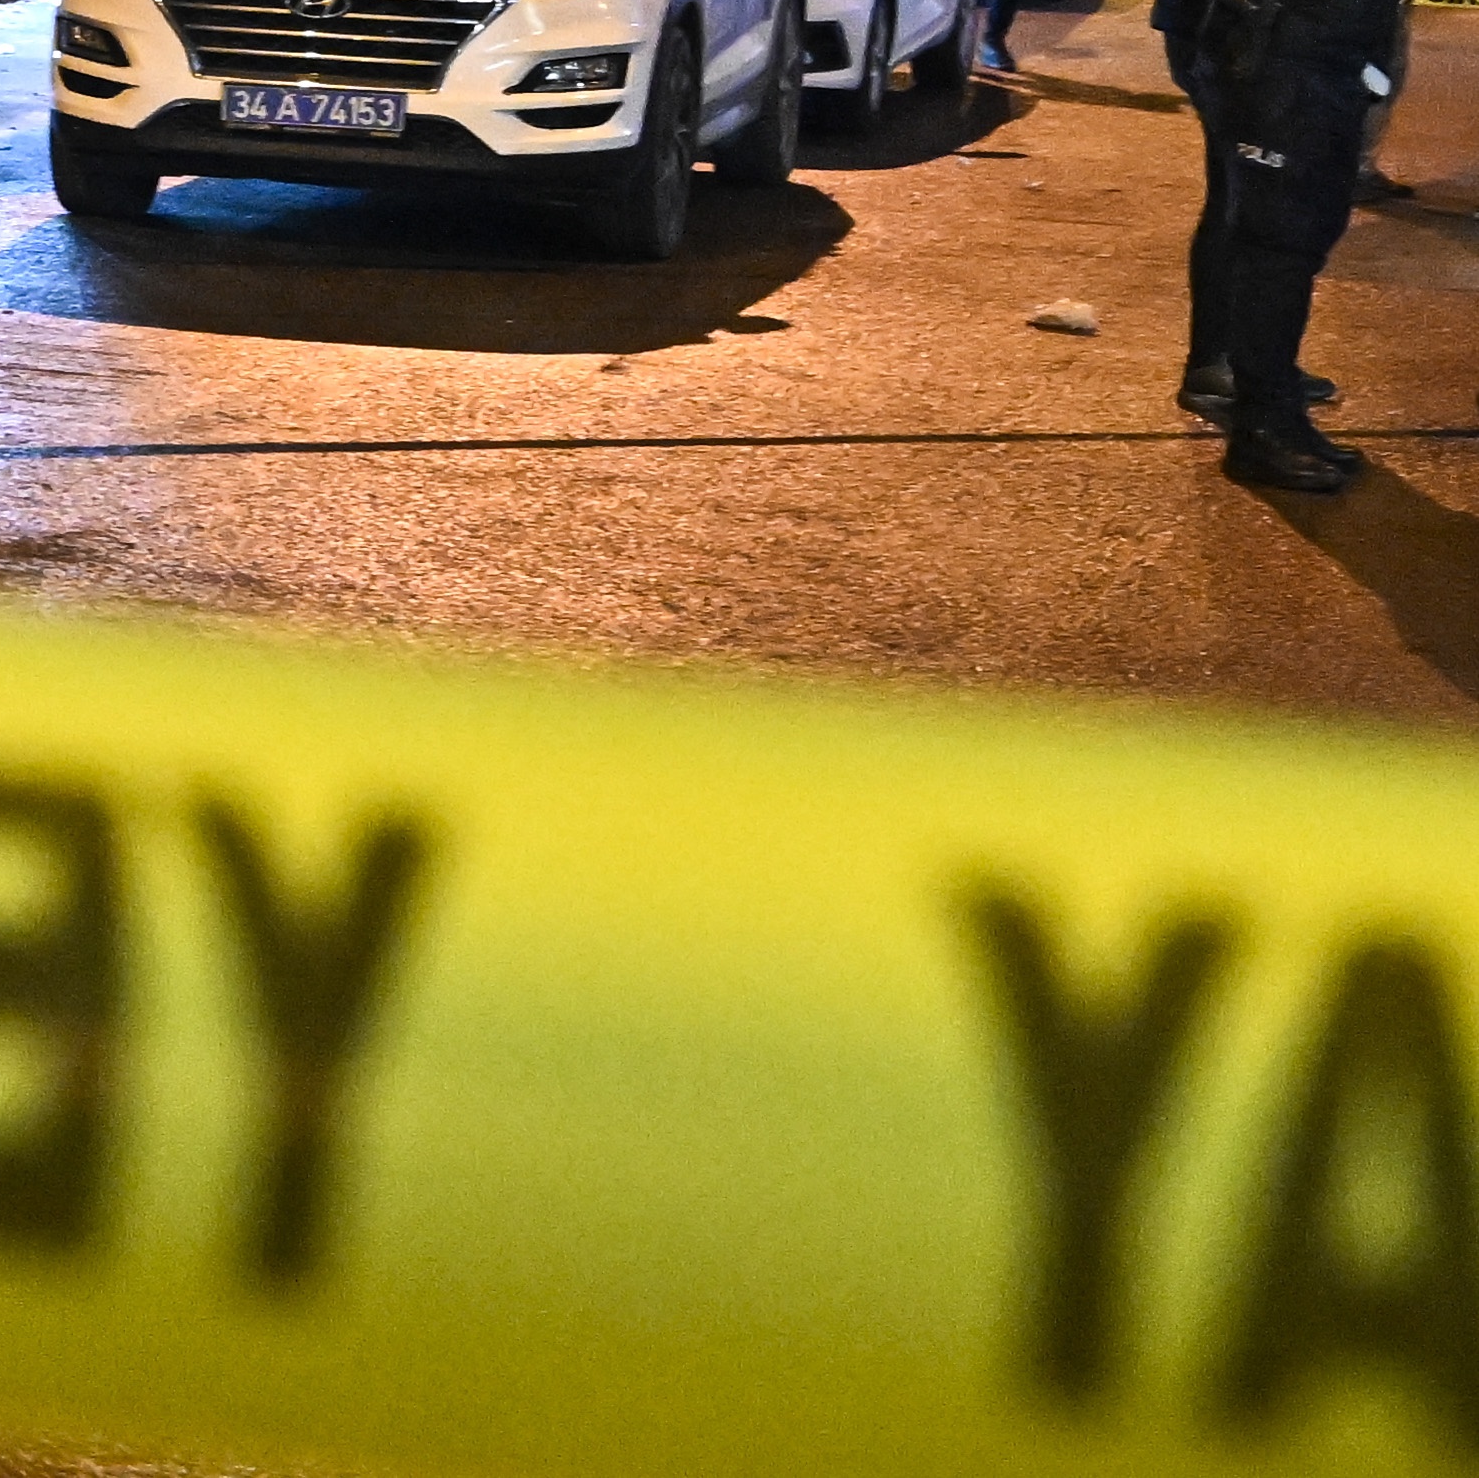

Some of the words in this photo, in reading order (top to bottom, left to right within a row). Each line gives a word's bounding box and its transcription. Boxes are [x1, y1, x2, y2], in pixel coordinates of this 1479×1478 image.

[232, 90, 268, 120] 34
[275, 93, 300, 121] A
[308, 94, 395, 126] 74153
